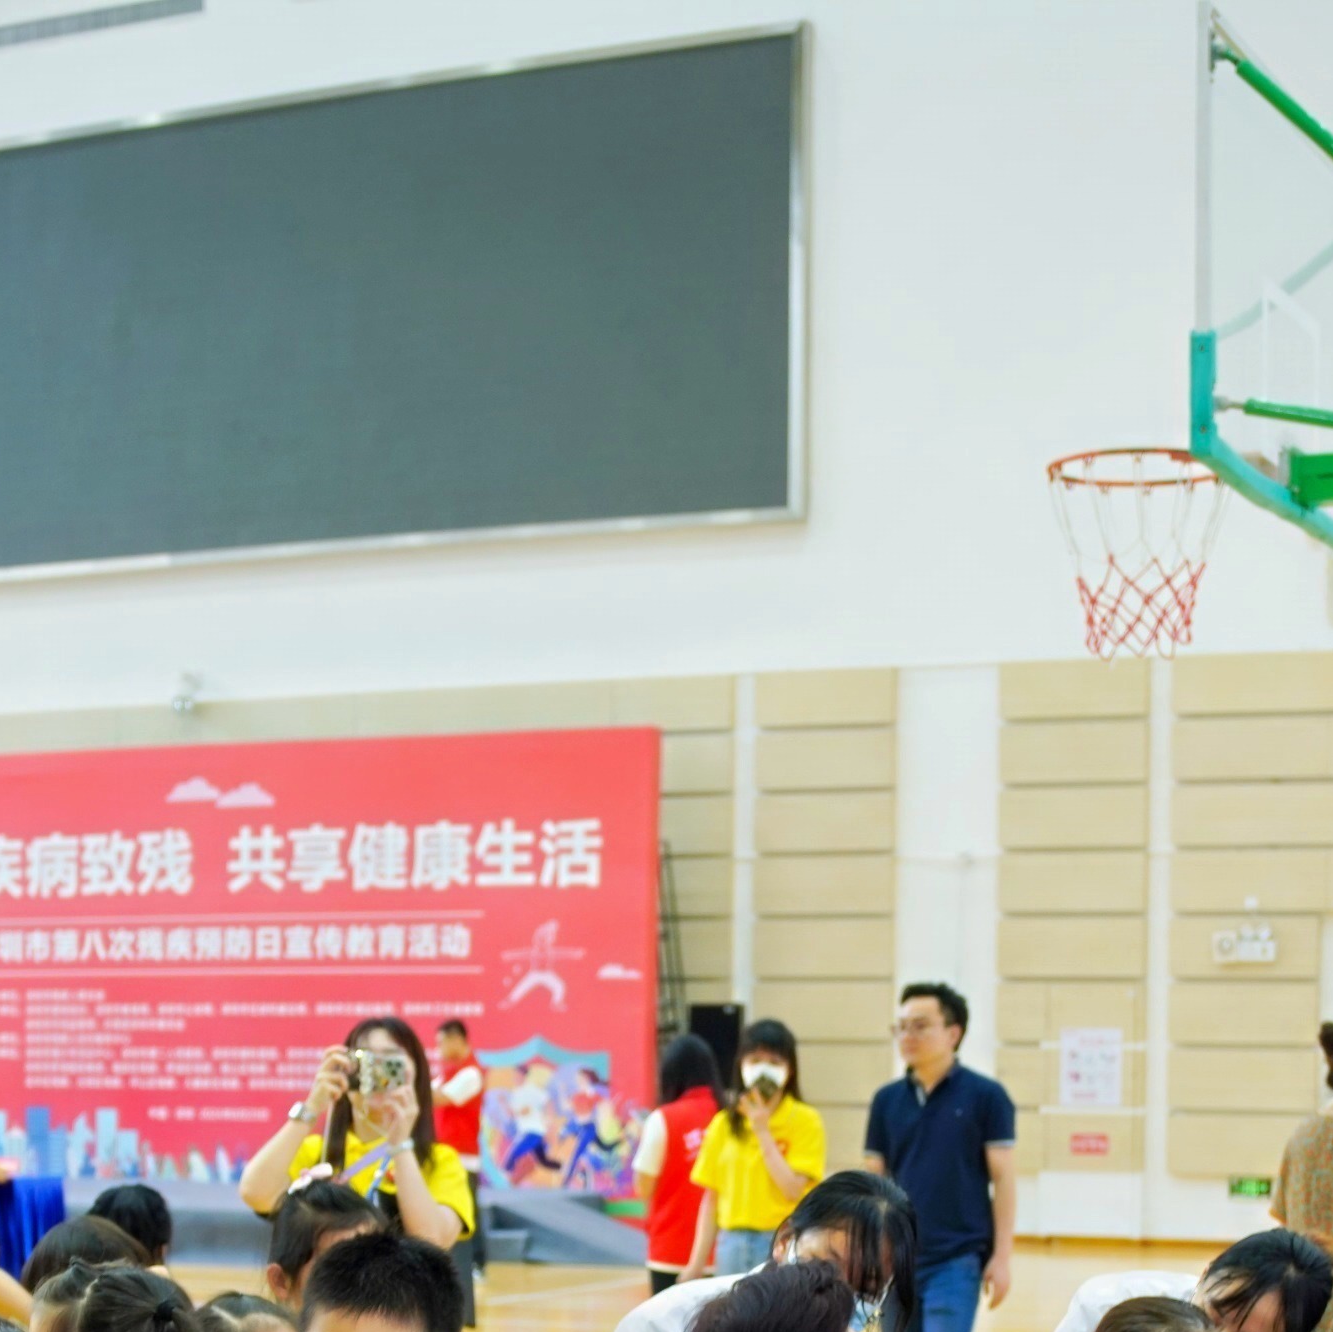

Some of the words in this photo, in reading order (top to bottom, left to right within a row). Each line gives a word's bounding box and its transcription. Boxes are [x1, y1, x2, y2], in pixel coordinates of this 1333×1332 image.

[226, 818, 604, 893] 共享健康生活
